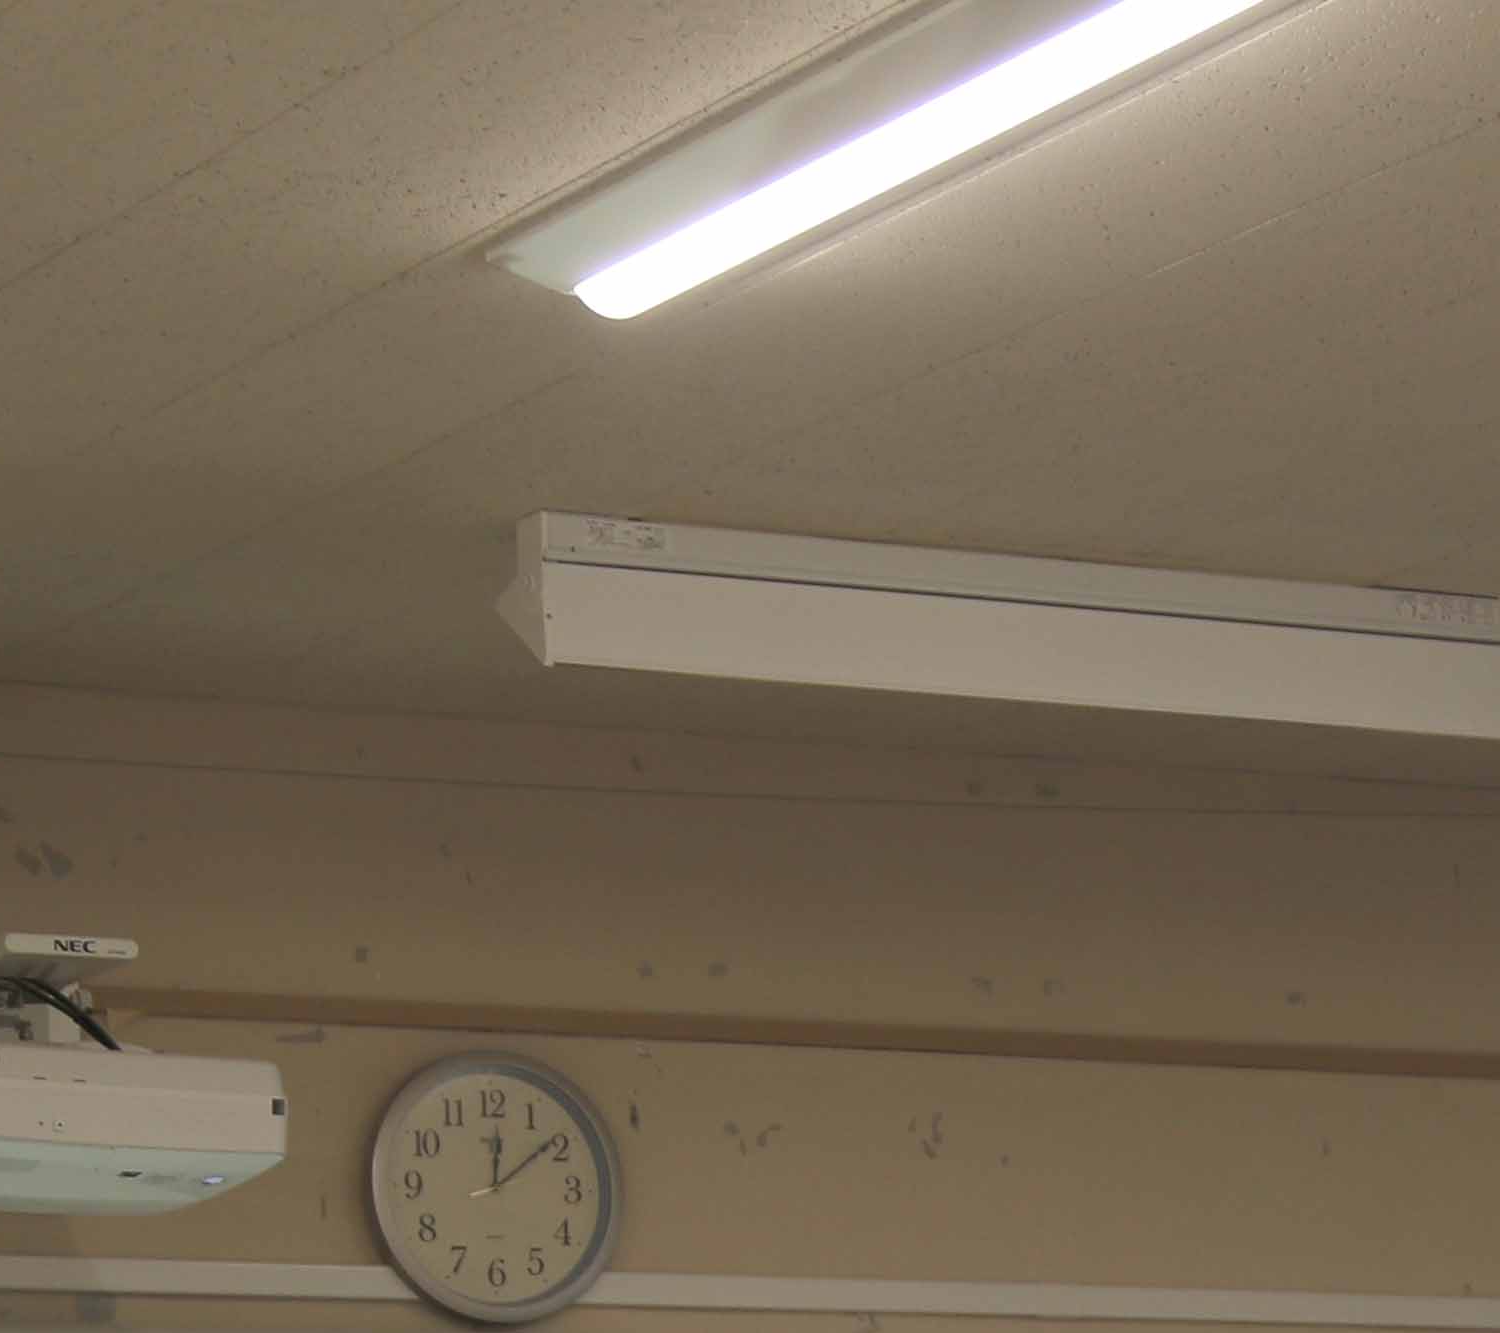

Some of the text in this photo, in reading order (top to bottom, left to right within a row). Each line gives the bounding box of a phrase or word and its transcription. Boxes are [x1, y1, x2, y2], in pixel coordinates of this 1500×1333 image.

[54, 939, 97, 954] NEC
[443, 1097, 465, 1127] 11
[479, 1089, 506, 1119] 12
[524, 1103, 536, 1131] 1
[414, 1129, 441, 1158] 10
[551, 1133, 570, 1162] 2
[404, 1169, 423, 1200] 9
[564, 1175, 583, 1204] 3
[418, 1213, 437, 1242] 8
[554, 1217, 572, 1247] 4
[450, 1245, 468, 1275] 7
[487, 1259, 507, 1287] 6
[527, 1247, 546, 1276] 5
